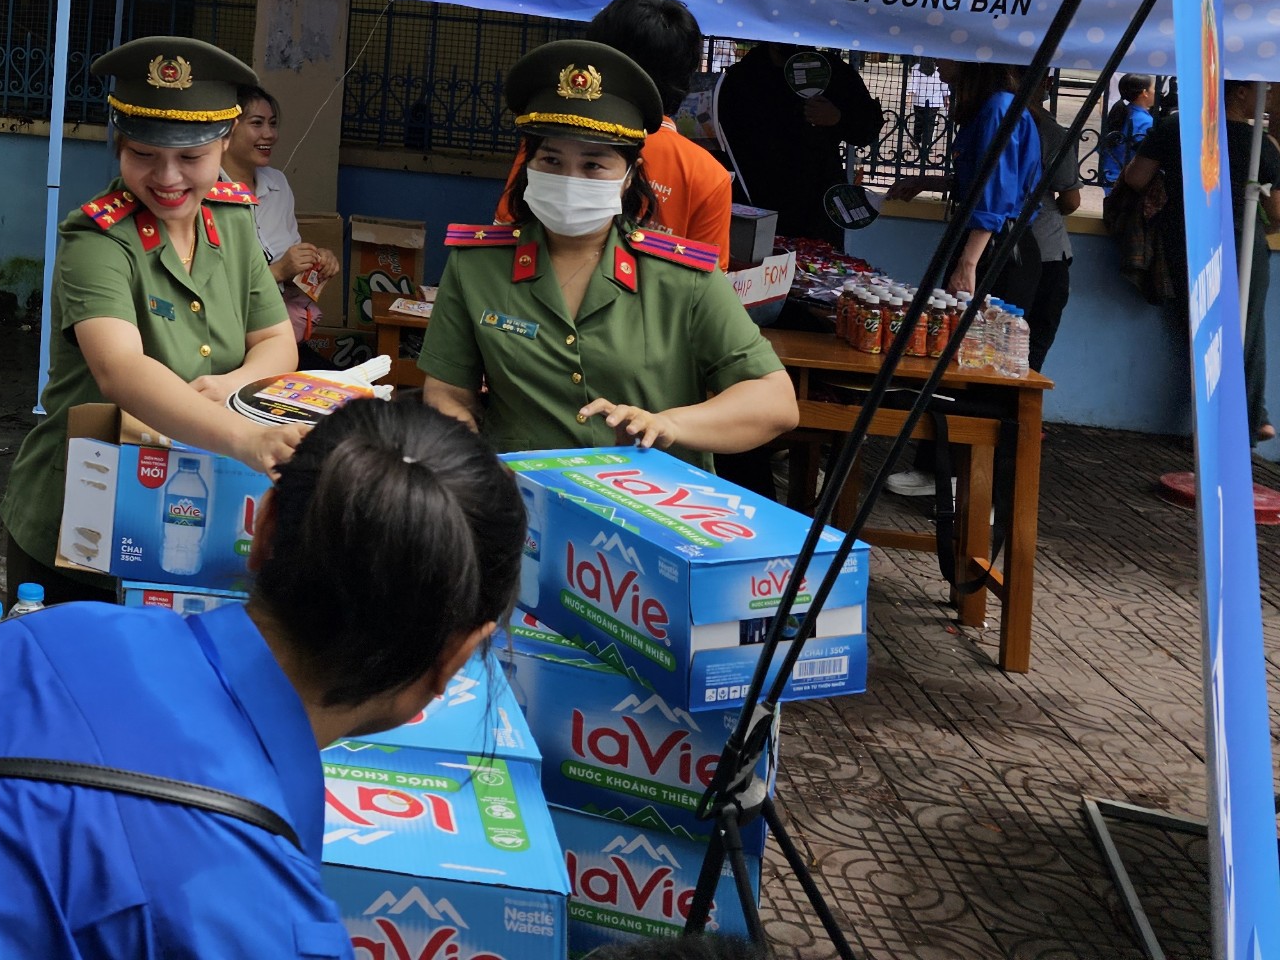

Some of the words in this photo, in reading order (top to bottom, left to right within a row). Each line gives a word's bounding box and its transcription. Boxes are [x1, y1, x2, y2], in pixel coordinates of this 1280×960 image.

[140, 466, 163, 478] MỚI
[170, 504, 201, 516] laVie
[595, 469, 756, 541] laVie
[121, 537, 133, 545] 24
[121, 545, 142, 554] CHAI
[566, 541, 670, 639] laVie
[325, 765, 389, 782] KHOÁN
[569, 765, 602, 782] NƯỚC
[606, 774, 658, 797] KHOÁNG
[662, 787, 697, 806] THIÊN
[504, 906, 554, 926] Nestlé
[570, 905, 593, 918] ƯỚC
[597, 912, 642, 930] KHOÁNG
[504, 920, 554, 937] Waters
